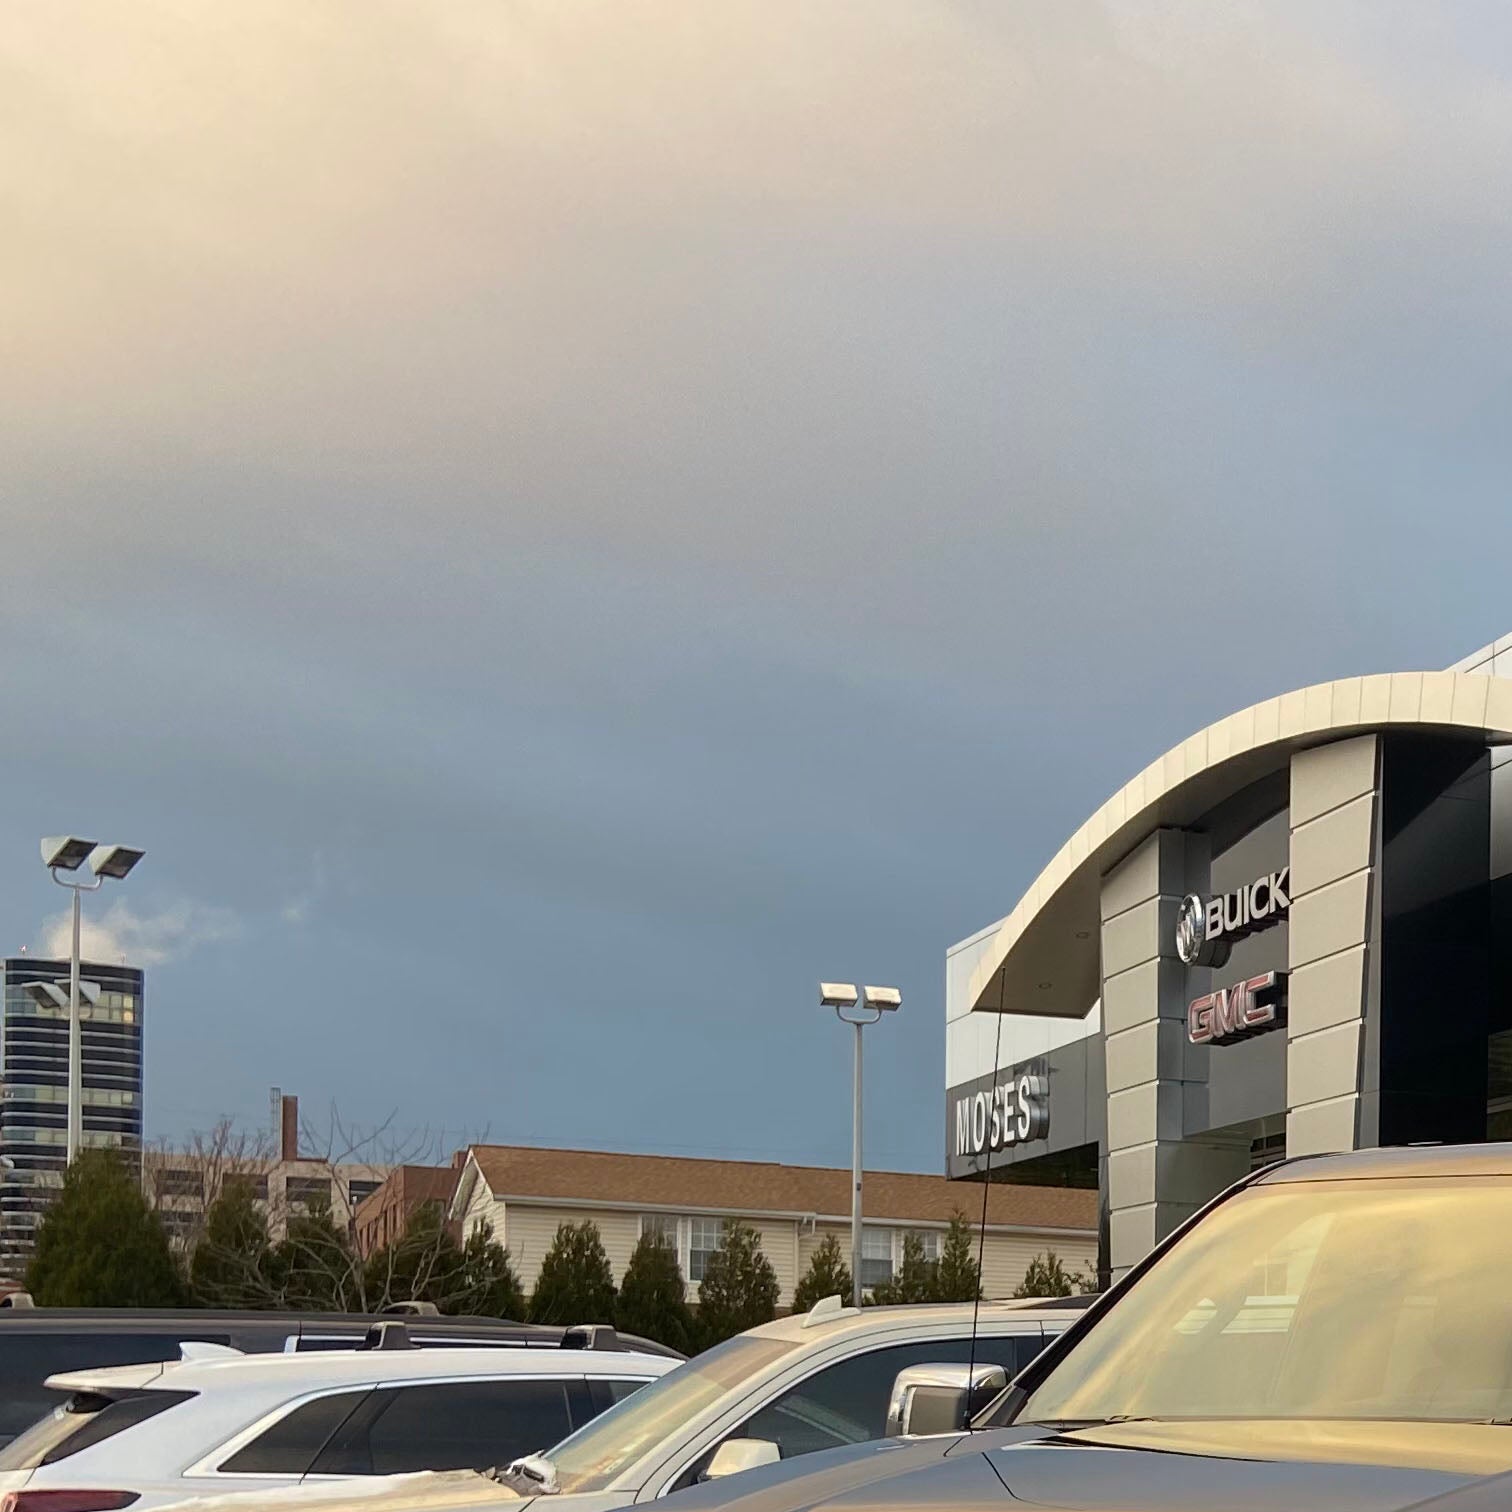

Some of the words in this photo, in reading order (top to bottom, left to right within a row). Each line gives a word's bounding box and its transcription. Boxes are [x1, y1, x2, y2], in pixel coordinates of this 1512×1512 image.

[1205, 866, 1291, 941] BUICK
[1187, 970, 1276, 1043] GMC
[956, 1075, 1034, 1156] MOSES
